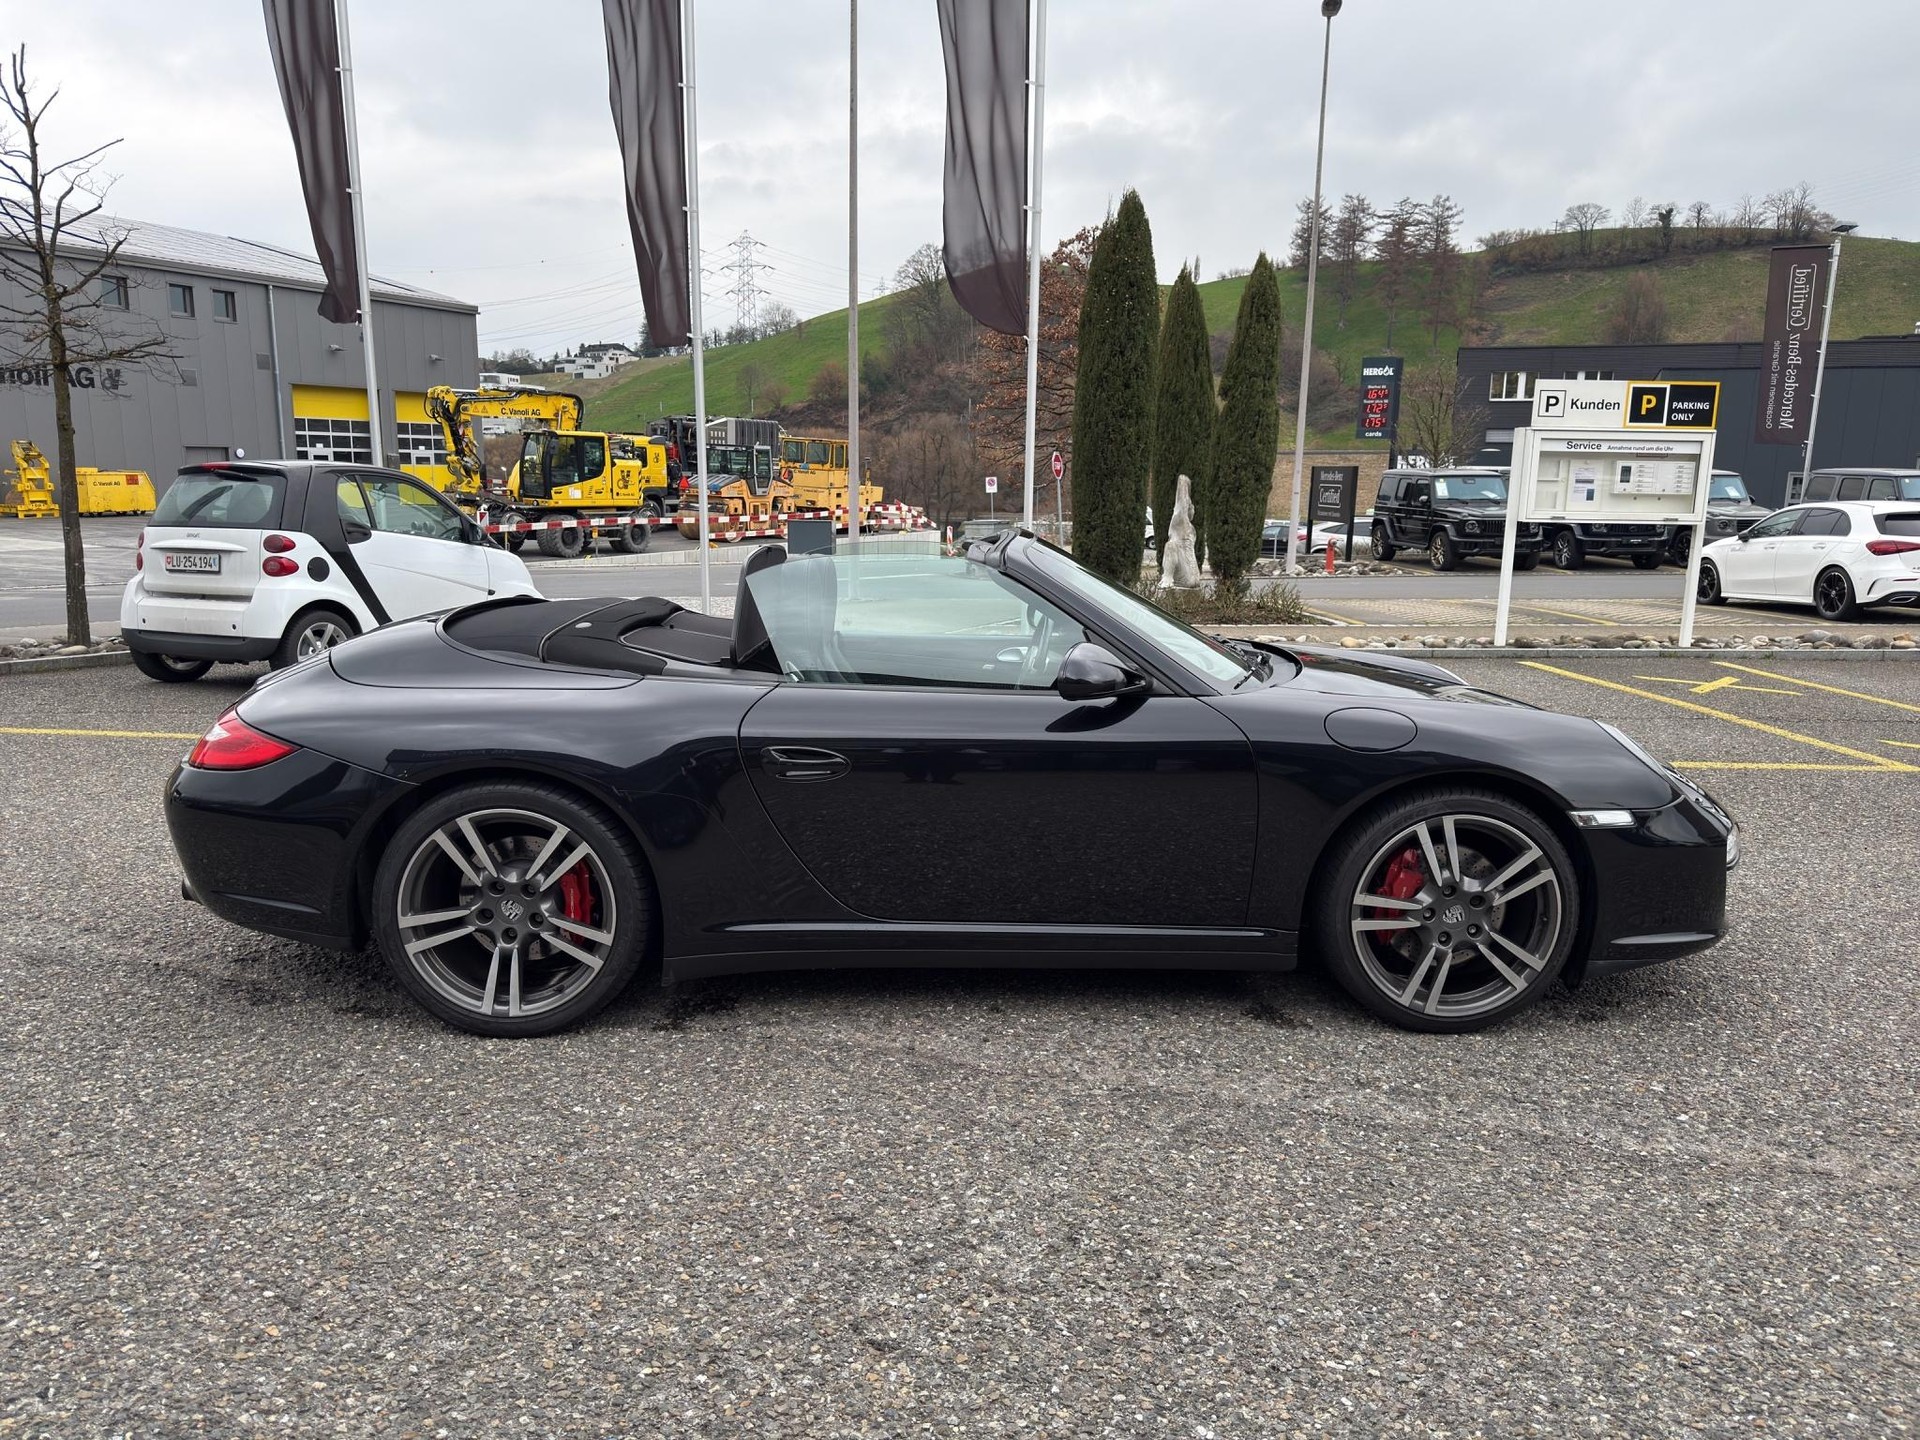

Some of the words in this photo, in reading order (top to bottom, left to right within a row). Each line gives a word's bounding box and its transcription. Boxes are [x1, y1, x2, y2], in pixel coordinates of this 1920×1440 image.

[1545, 395, 1560, 413] P
[1570, 398, 1620, 410] Kunden
[1641, 394, 1657, 415] P
[1672, 401, 1710, 410] PARKING
[501, 407, 508, 415] C.
[509, 408, 529, 416] Vanoli
[1671, 413, 1694, 421] ONLY
[1566, 440, 1602, 450] Service
[1319, 488, 1341, 503] Certified
